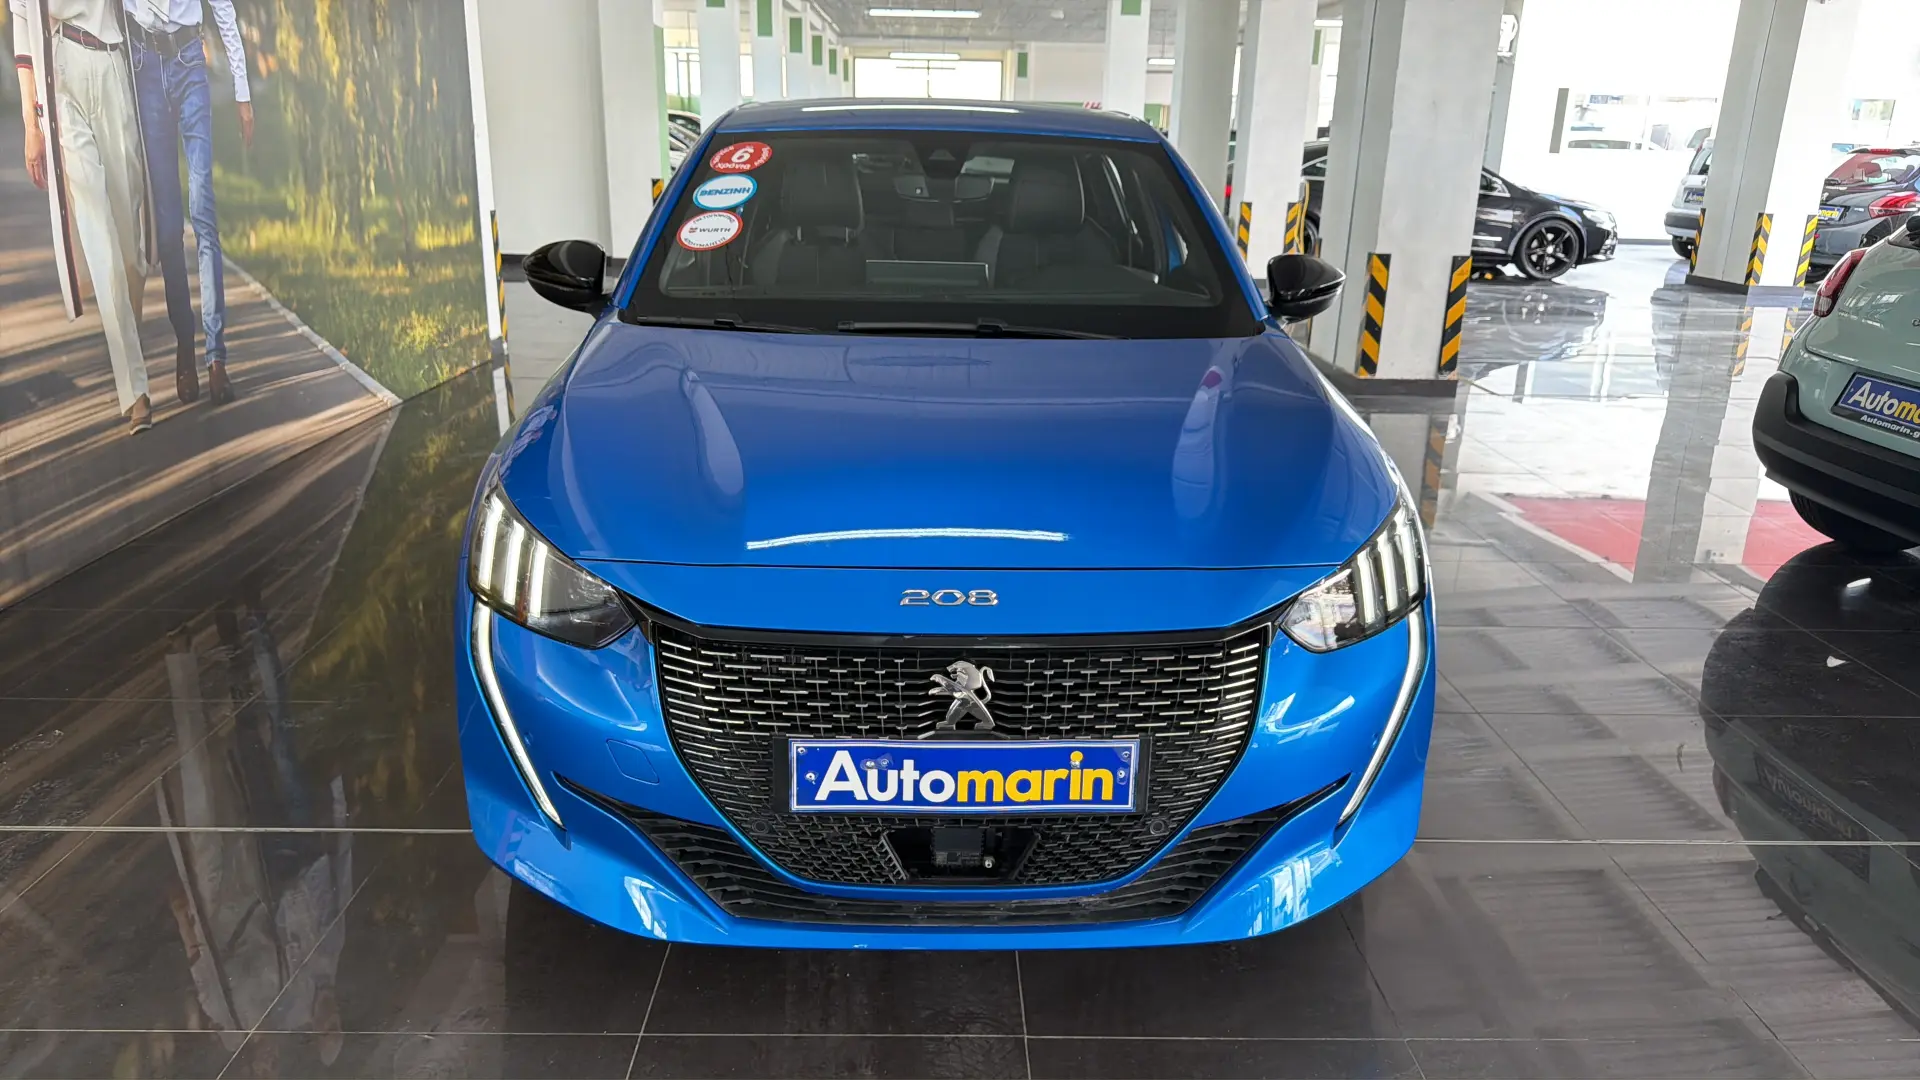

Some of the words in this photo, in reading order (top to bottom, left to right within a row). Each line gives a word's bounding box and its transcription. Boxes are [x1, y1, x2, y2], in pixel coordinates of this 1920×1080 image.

[731, 148, 754, 163] 6
[900, 589, 999, 606] 208
[814, 749, 1114, 803] Automarin
